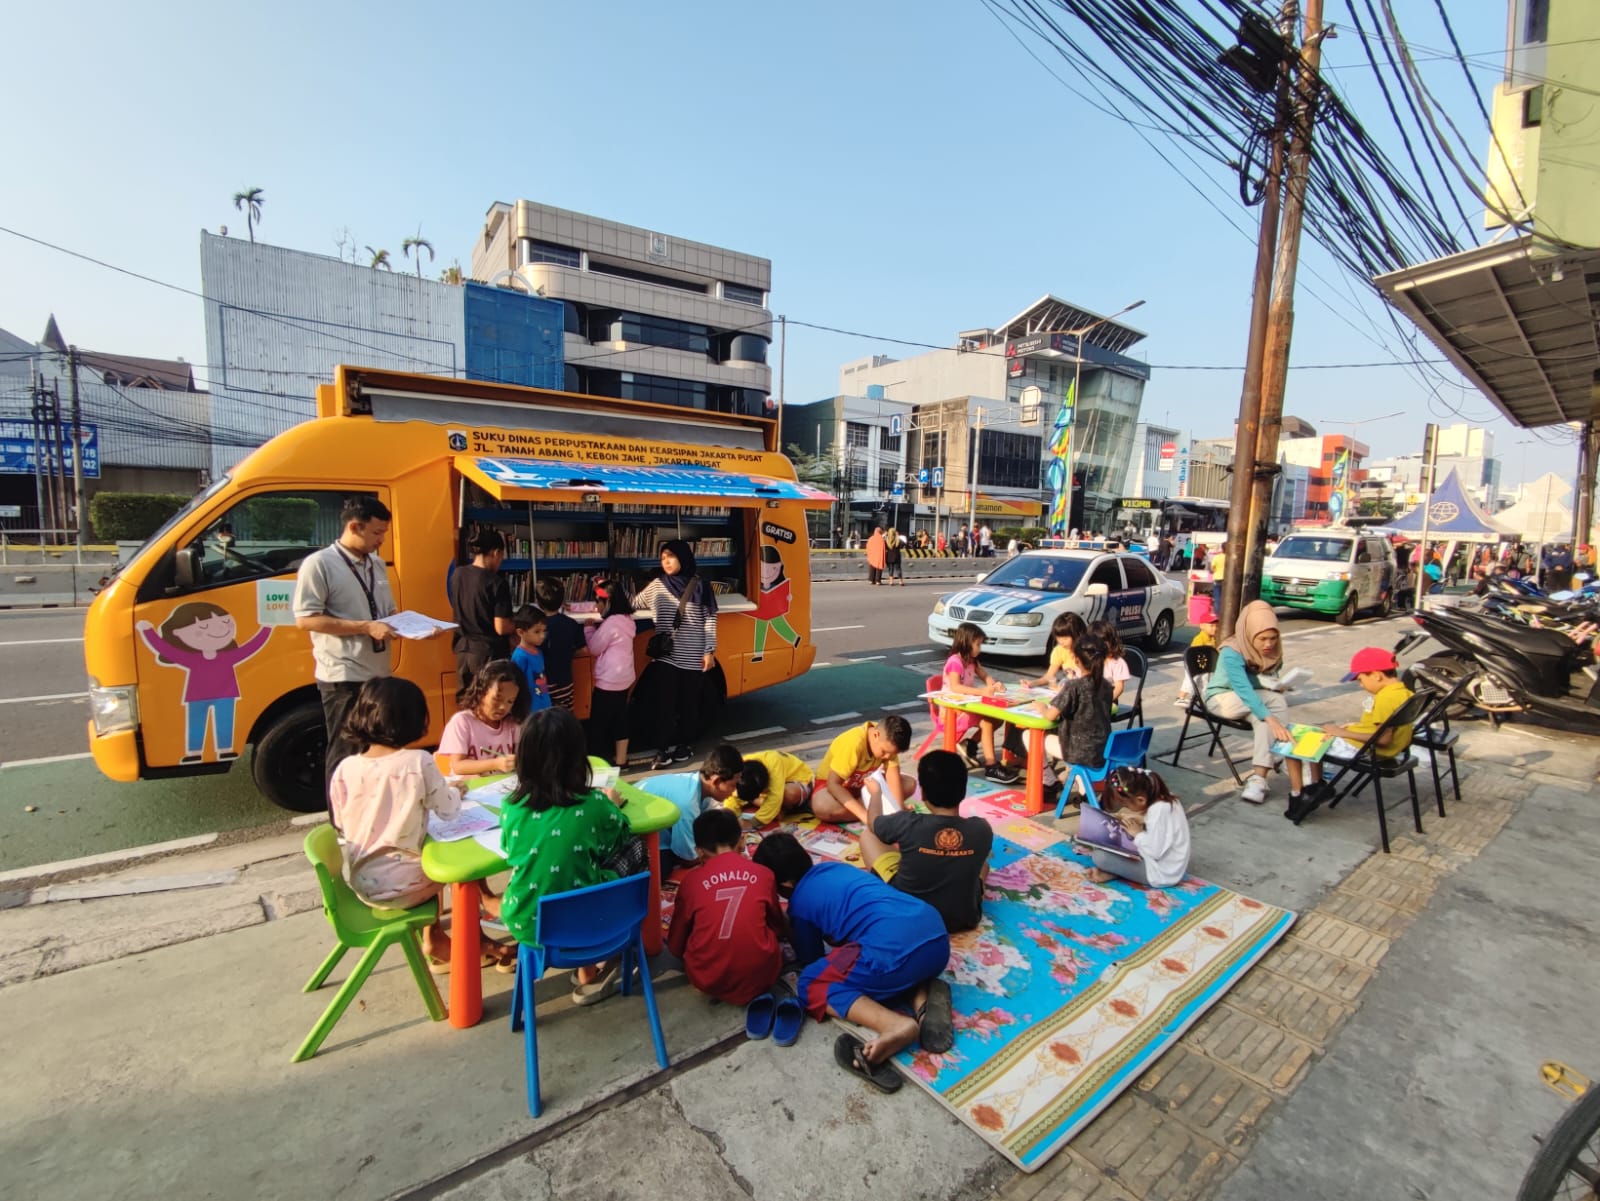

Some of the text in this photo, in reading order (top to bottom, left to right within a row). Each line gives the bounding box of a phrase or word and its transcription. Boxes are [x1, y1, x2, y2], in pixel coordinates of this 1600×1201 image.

[472, 431, 763, 463] SUKU DINAS PERPUSTAKAAN DAN KEARSIPAN JAKARTA PUSAT
[473, 443, 494, 453] JL.
[498, 444, 535, 456] TANAH
[538, 447, 573, 458] ABANG
[586, 451, 619, 462] KEBON
[621, 453, 645, 463] JAHE
[654, 456, 693, 467] JAKARTA
[694, 459, 721, 469] PUSAT
[974, 504, 1002, 512] anamon
[764, 524, 793, 541] GRATIS!
[266, 593, 289, 602] LOVE
[1120, 604, 1142, 617] POLISI
[702, 870, 758, 890] RONALDO
[715, 885, 748, 940] 7
